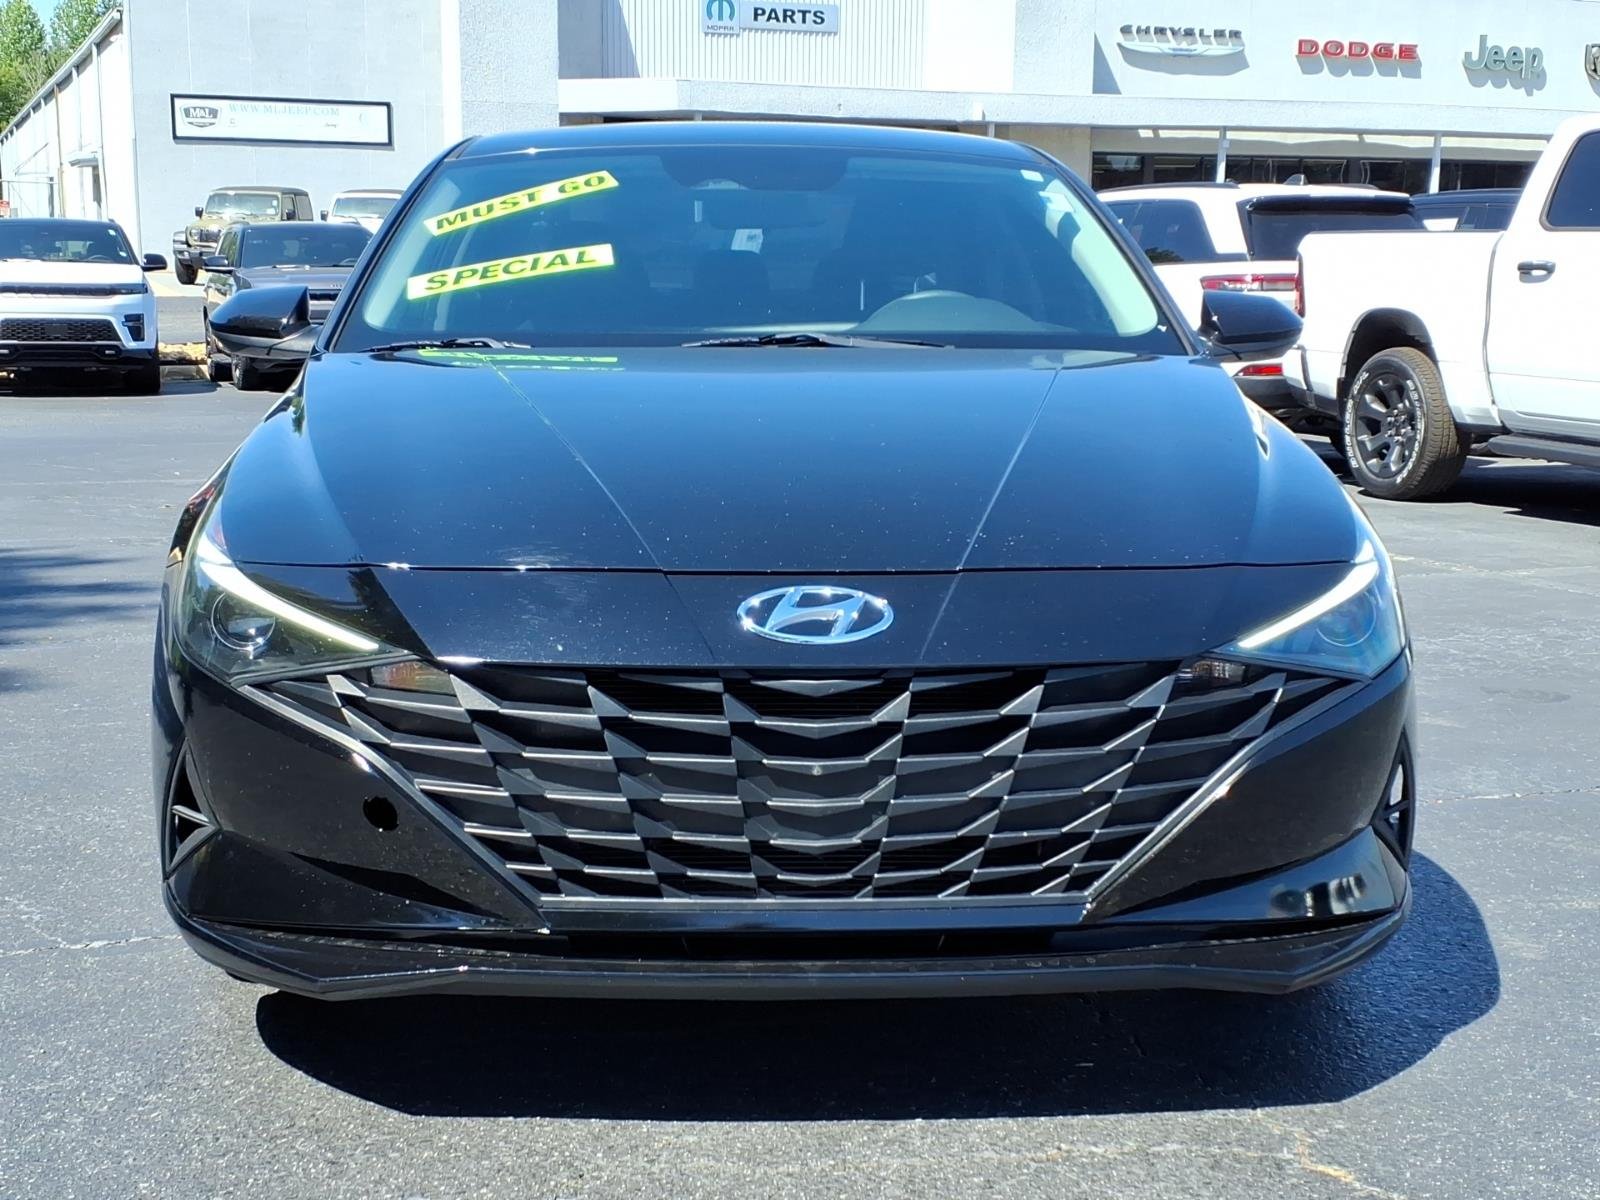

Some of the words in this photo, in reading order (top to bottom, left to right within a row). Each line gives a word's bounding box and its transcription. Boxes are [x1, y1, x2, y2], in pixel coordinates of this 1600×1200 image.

[753, 7, 825, 25] PARTS
[1120, 24, 1242, 39] CHRYSLER
[1298, 39, 1418, 60] DODGE
[1464, 34, 1544, 79] Jeep
[436, 190, 545, 230] MUST
[558, 175, 606, 194] GO
[424, 250, 597, 291] SPECIAL
